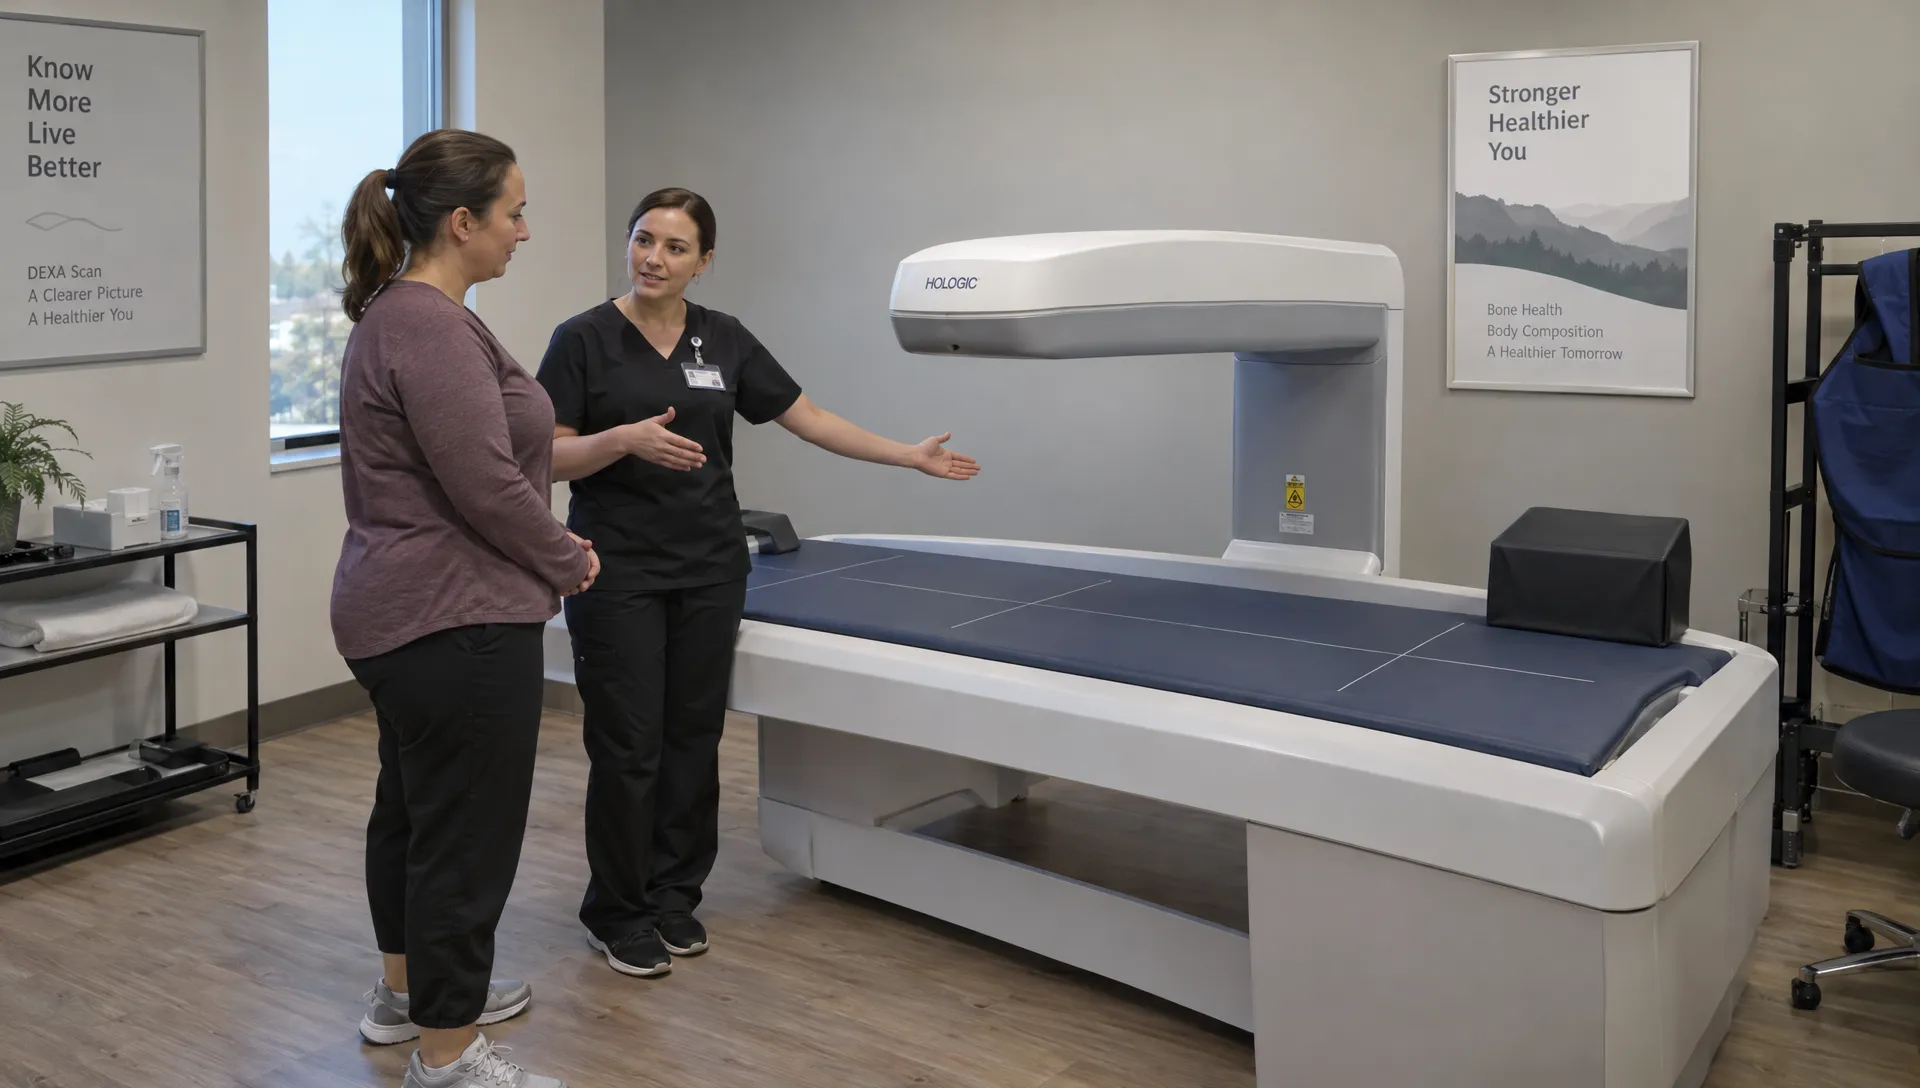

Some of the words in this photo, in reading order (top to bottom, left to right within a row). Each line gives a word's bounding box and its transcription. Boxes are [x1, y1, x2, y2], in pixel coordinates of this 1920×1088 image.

[28, 55, 93, 80] Know
[28, 88, 91, 113] More
[1489, 85, 1581, 106] Stronger
[1489, 110, 1590, 132] Healthier
[28, 121, 76, 144] Live
[1488, 142, 1527, 161] You
[28, 155, 101, 177] Better
[28, 266, 66, 279] DEXA
[71, 265, 102, 278] Scan
[925, 277, 978, 289] HOLOGIC
[28, 289, 38, 302] A
[43, 288, 92, 302] Clearer
[98, 286, 143, 299] Picture
[28, 312, 38, 325] A
[43, 309, 105, 325] Healthier
[110, 308, 133, 321] You
[1487, 303, 1517, 316] Bone
[1522, 303, 1562, 316] Health
[1487, 324, 1518, 340] Body
[1522, 325, 1604, 340] Composition
[1487, 346, 1496, 358] A
[1500, 346, 1556, 359] Healthier
[1561, 347, 1623, 360] Tomorrow
